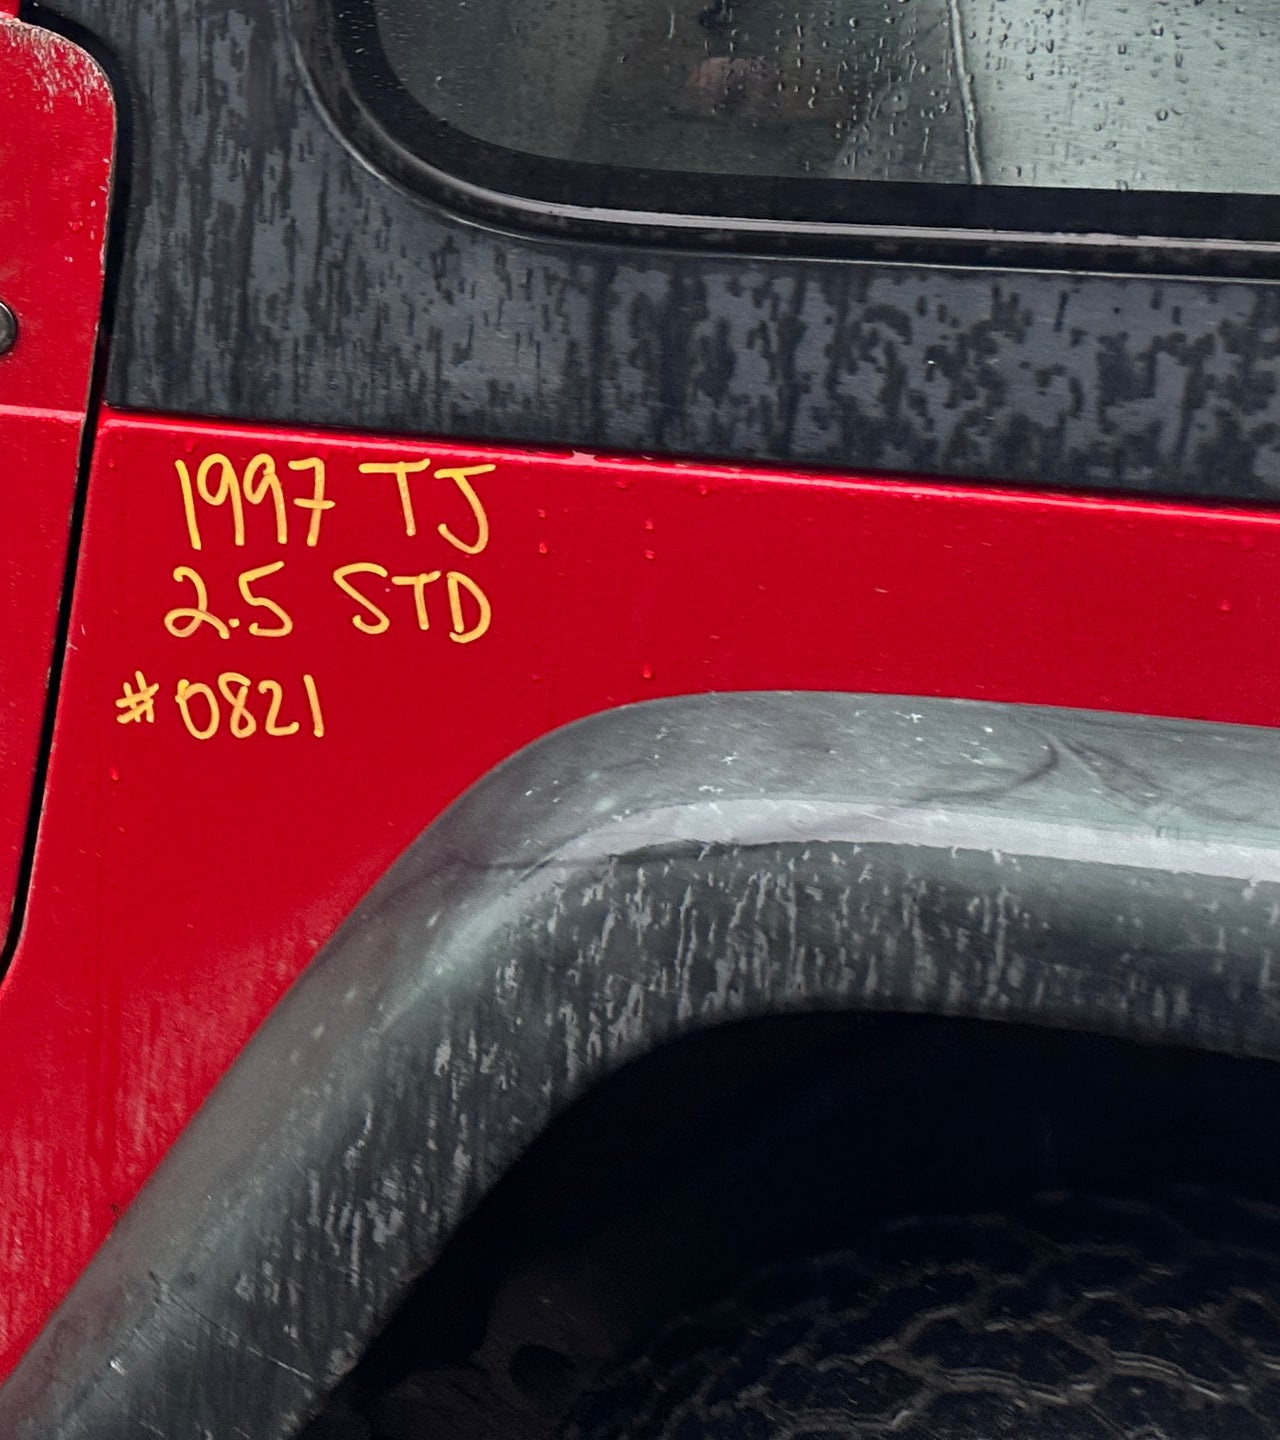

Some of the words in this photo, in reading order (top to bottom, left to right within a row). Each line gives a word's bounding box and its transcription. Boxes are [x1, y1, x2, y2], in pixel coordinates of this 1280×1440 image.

[174, 452, 336, 551] 1997
[358, 457, 496, 555] TJ
[163, 560, 294, 640] 2.5
[333, 561, 493, 644] STD
[115, 670, 326, 740] #0821
